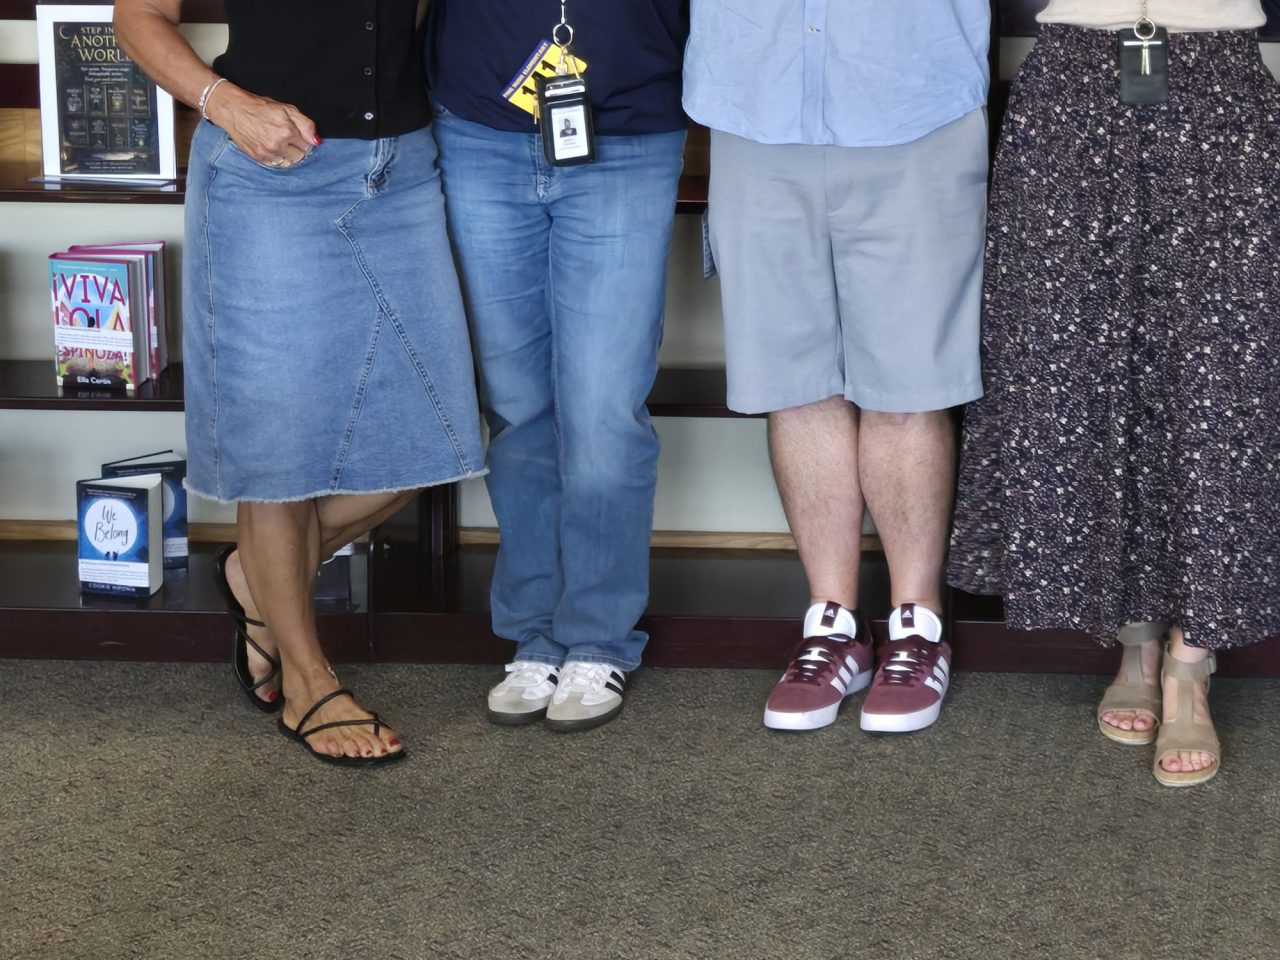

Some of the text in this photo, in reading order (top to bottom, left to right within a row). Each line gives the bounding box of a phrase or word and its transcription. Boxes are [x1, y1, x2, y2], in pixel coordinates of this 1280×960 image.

[81, 26, 102, 34] STEP
[78, 49, 132, 63] WORL
[53, 272, 126, 306] ¡VIVA
[102, 505, 117, 524] We
[95, 522, 129, 546] Belong
